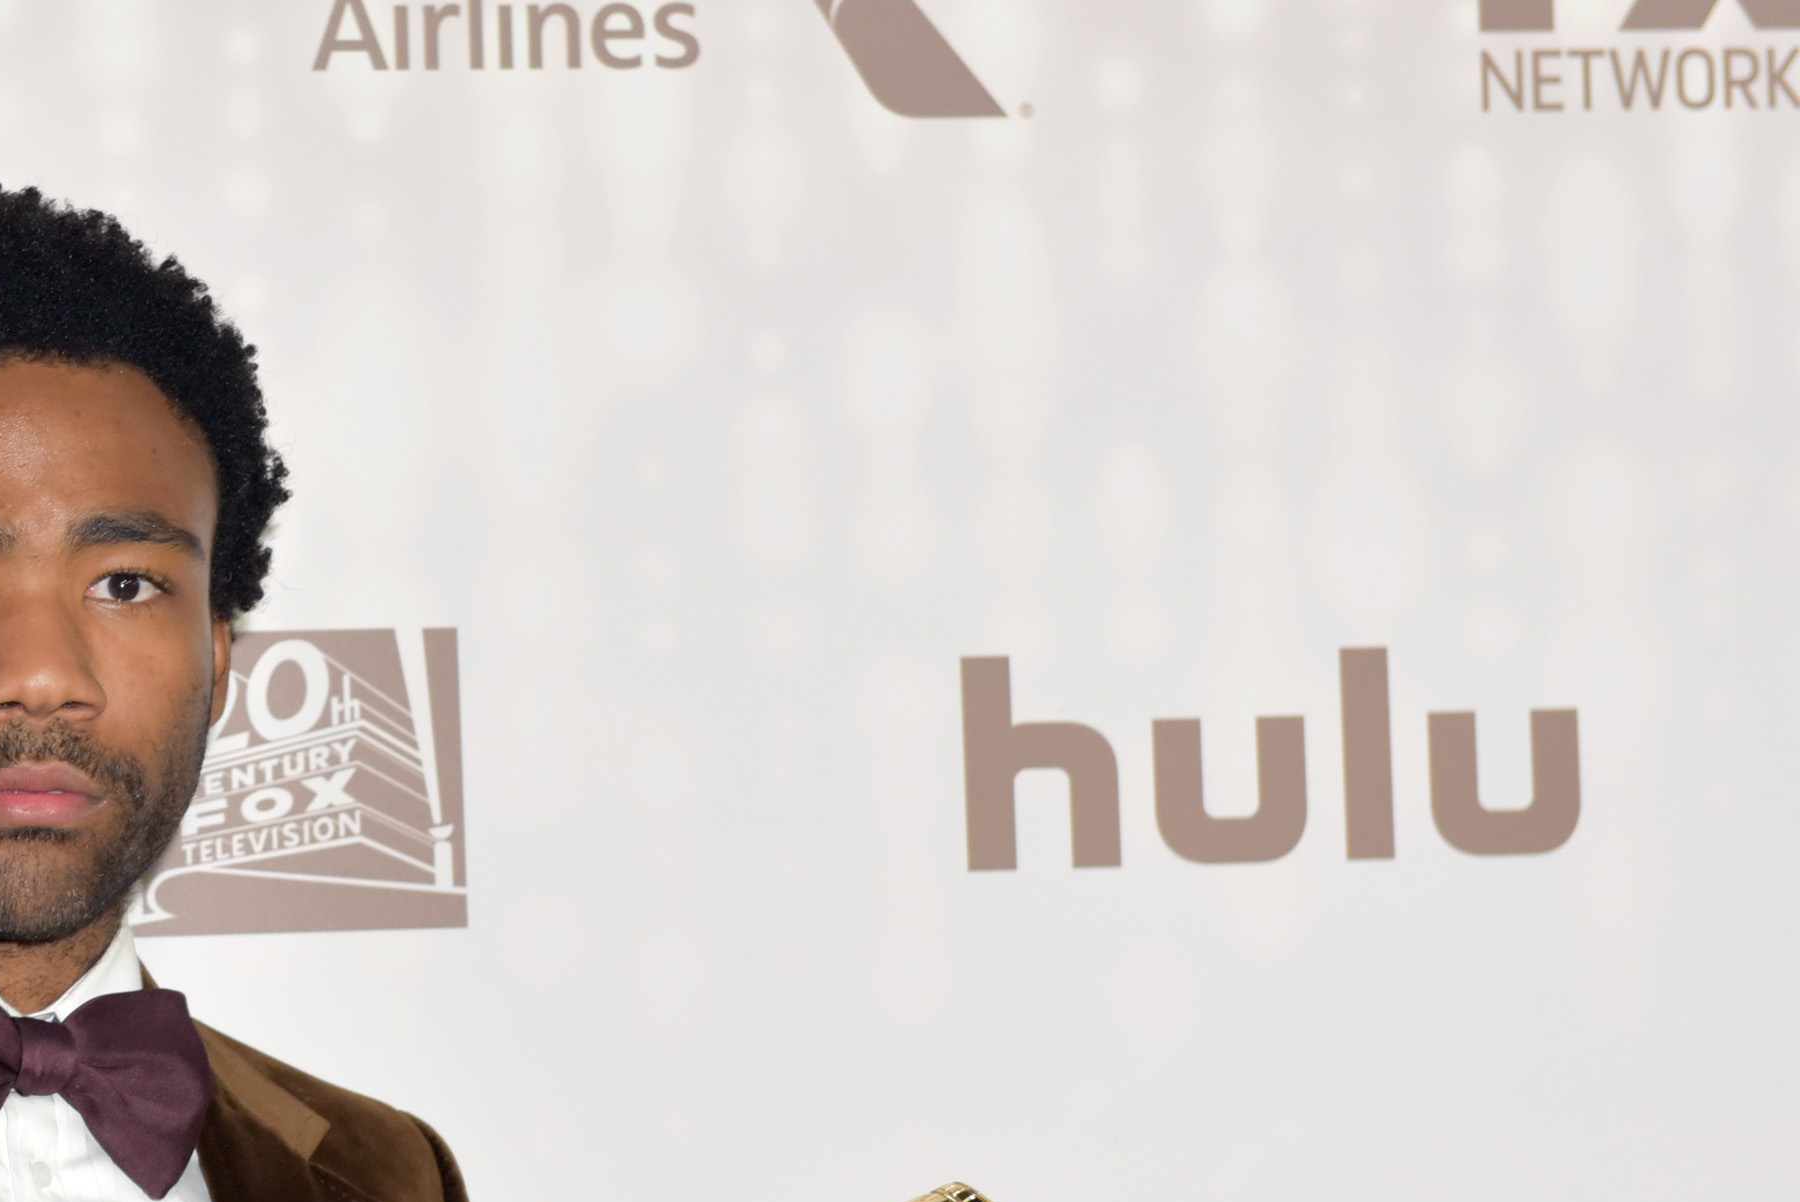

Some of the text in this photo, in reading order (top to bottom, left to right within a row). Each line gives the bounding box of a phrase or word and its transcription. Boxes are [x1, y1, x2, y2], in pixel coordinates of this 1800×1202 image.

[312, 0, 700, 71] Airlines
[203, 737, 357, 796] ENTURY
[960, 646, 1582, 872] hulu
[181, 768, 358, 837] FOX
[181, 809, 361, 866] TELEVISION
